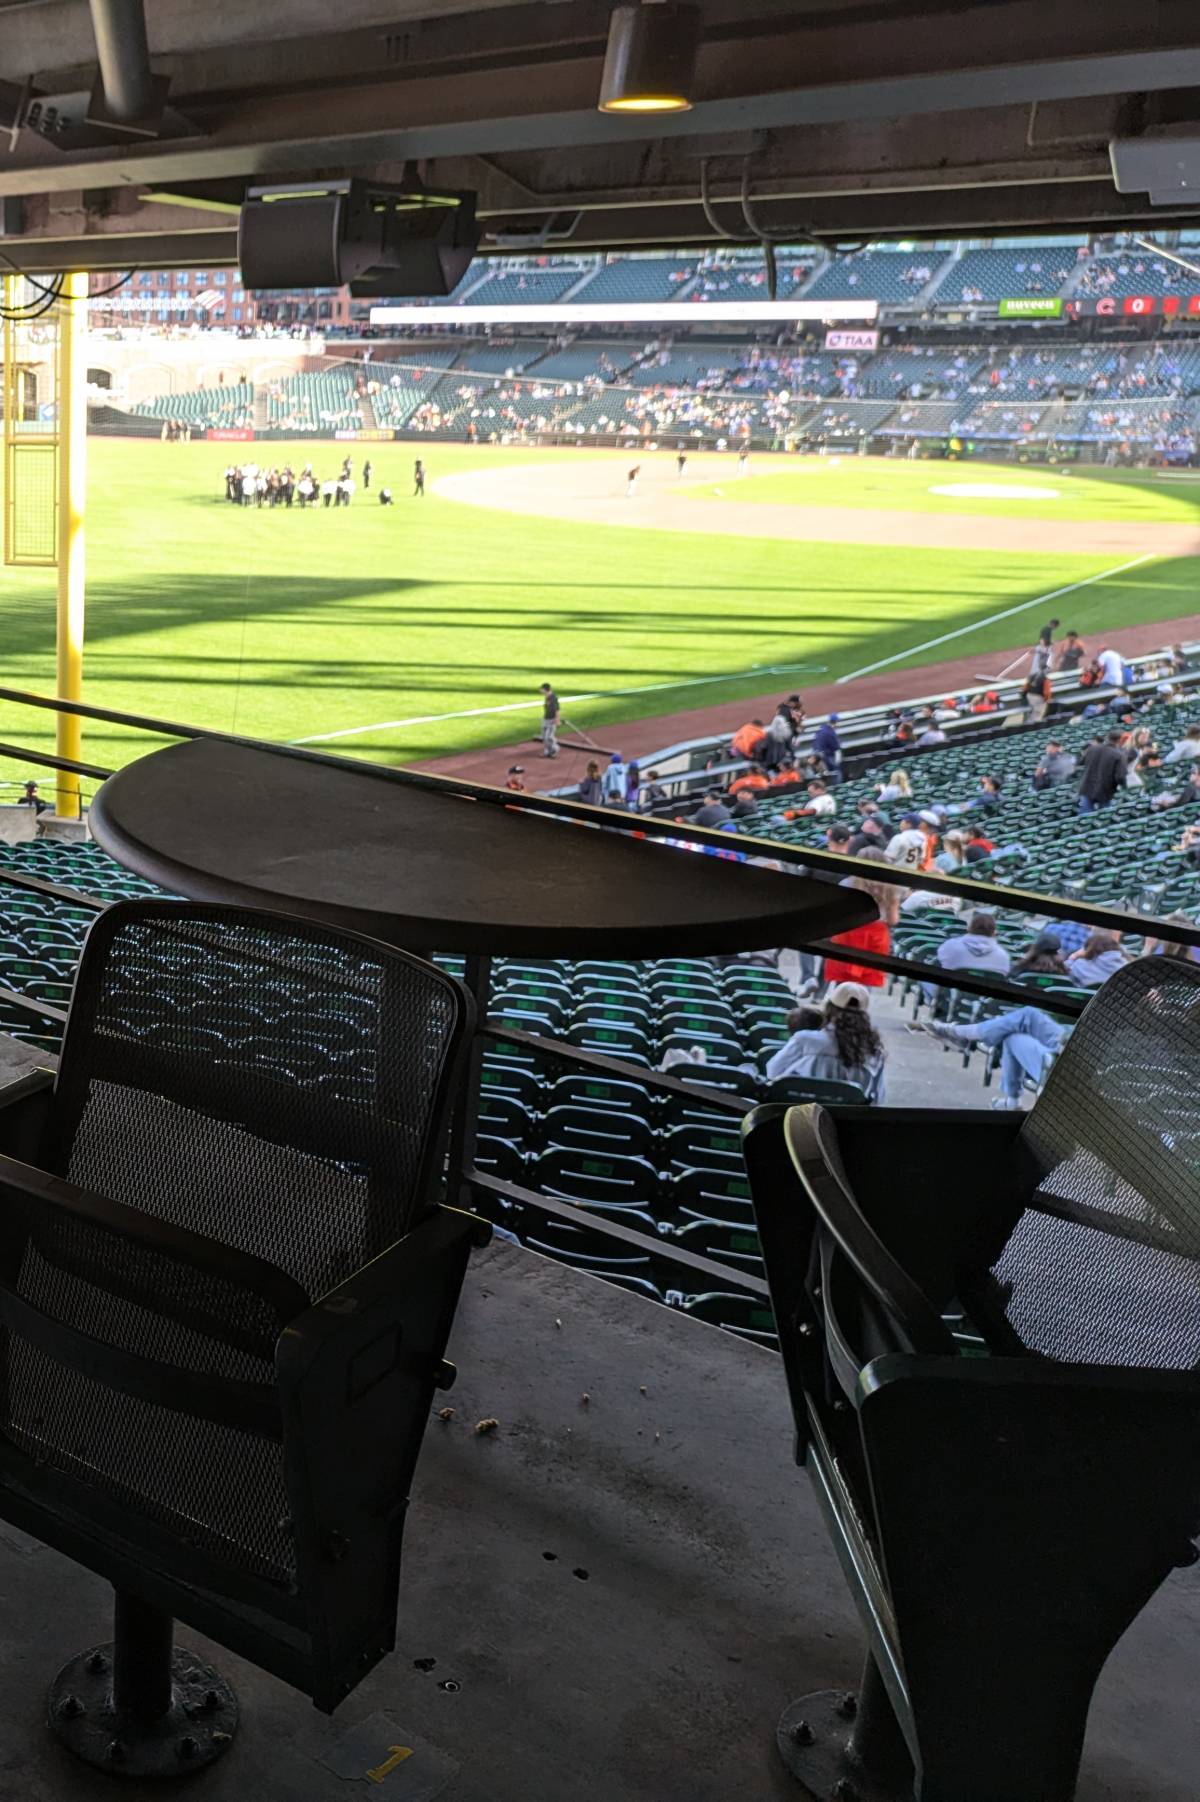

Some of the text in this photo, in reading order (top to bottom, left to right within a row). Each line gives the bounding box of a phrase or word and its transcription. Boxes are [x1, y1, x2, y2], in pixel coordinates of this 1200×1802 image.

[1006, 299, 1056, 311] nuveen
[844, 335, 874, 346] TIAA
[366, 1745, 414, 1784] 1
